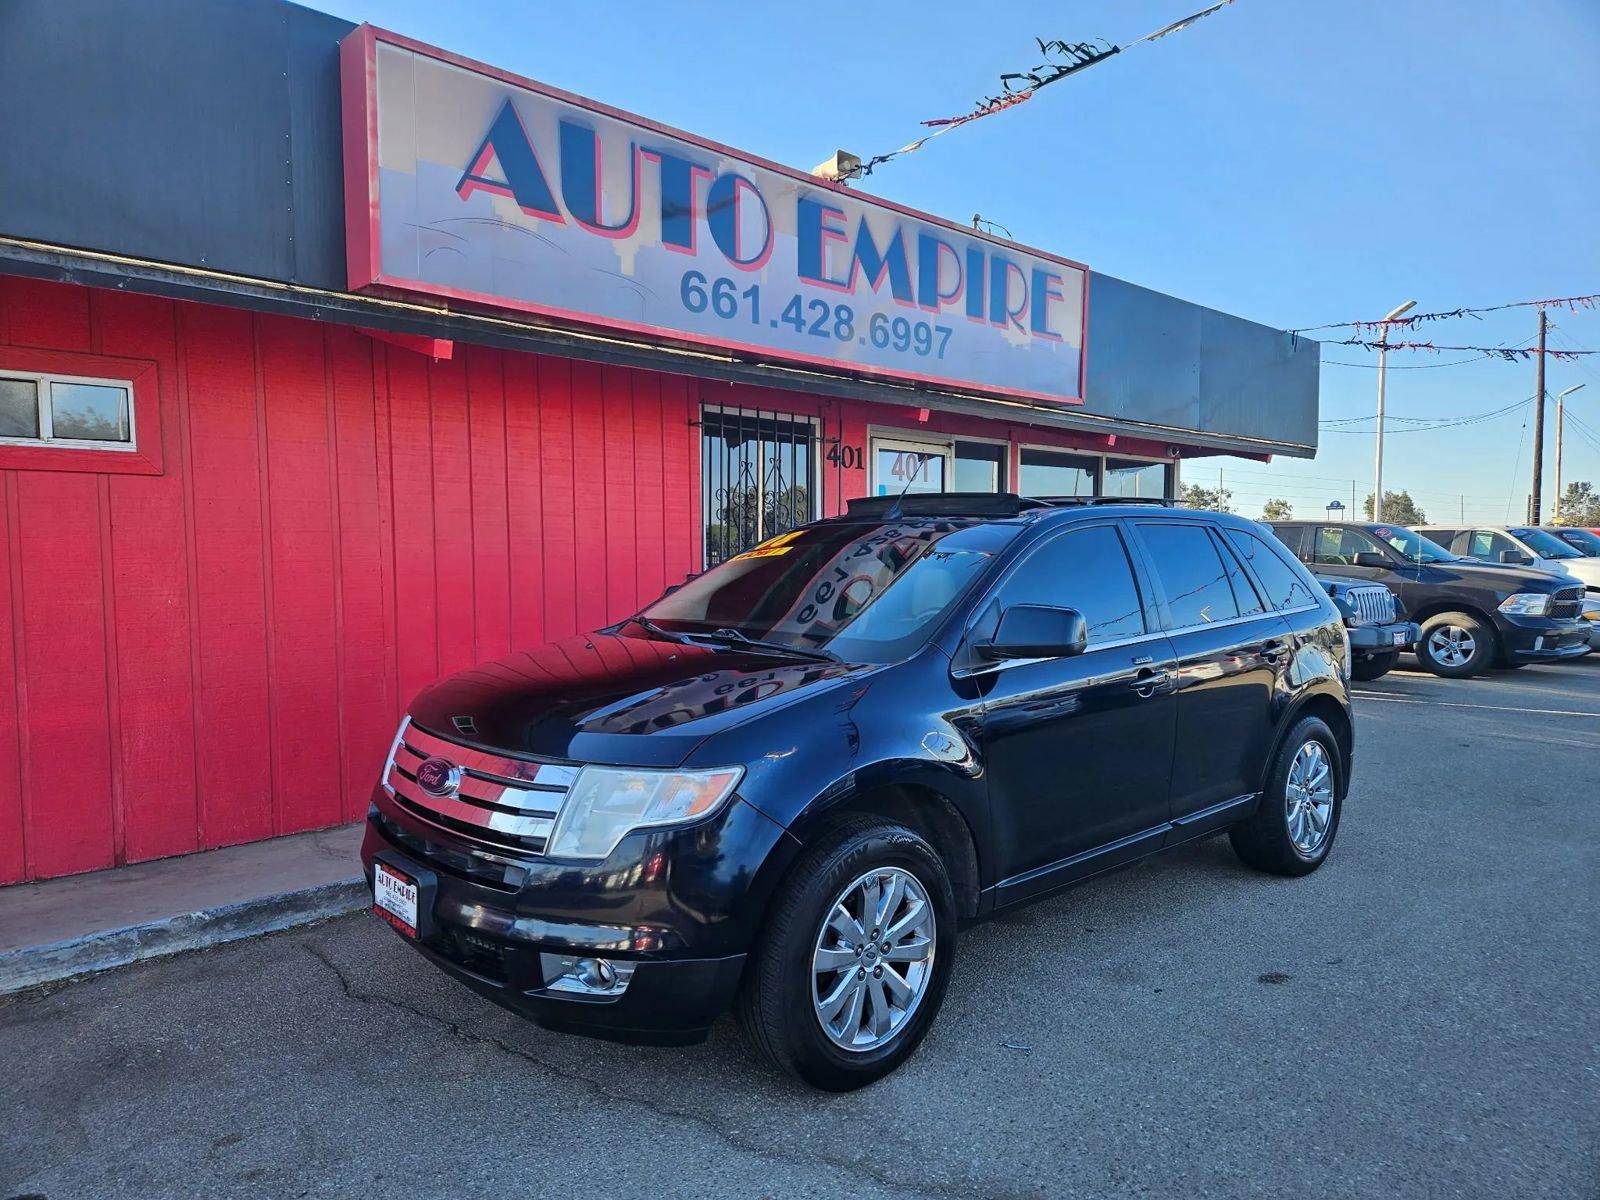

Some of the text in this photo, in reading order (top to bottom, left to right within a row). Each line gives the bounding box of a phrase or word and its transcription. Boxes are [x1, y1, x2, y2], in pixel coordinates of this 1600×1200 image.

[454, 97, 1065, 344] AUTO EMPIRE
[680, 269, 953, 360] 661.428.6997
[826, 439, 865, 470] 401
[890, 452, 929, 483] 401
[420, 764, 443, 786] Ford
